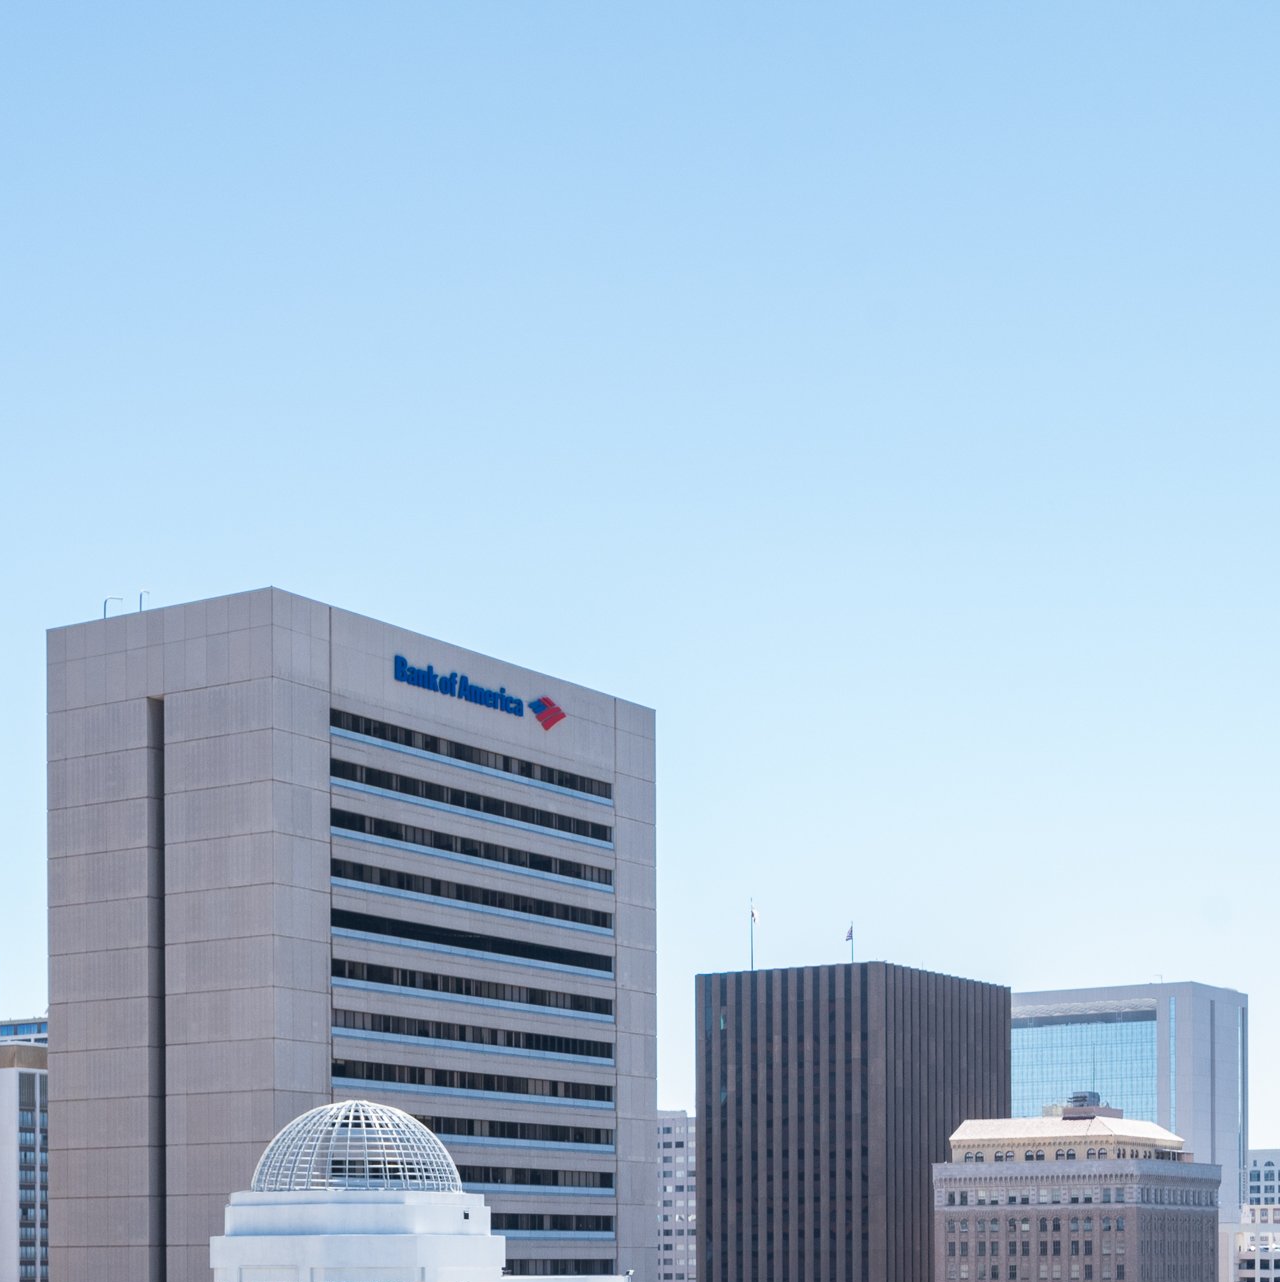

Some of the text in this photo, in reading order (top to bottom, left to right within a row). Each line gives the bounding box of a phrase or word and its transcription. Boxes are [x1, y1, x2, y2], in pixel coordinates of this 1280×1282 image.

[394, 654, 524, 717] Bank of America
